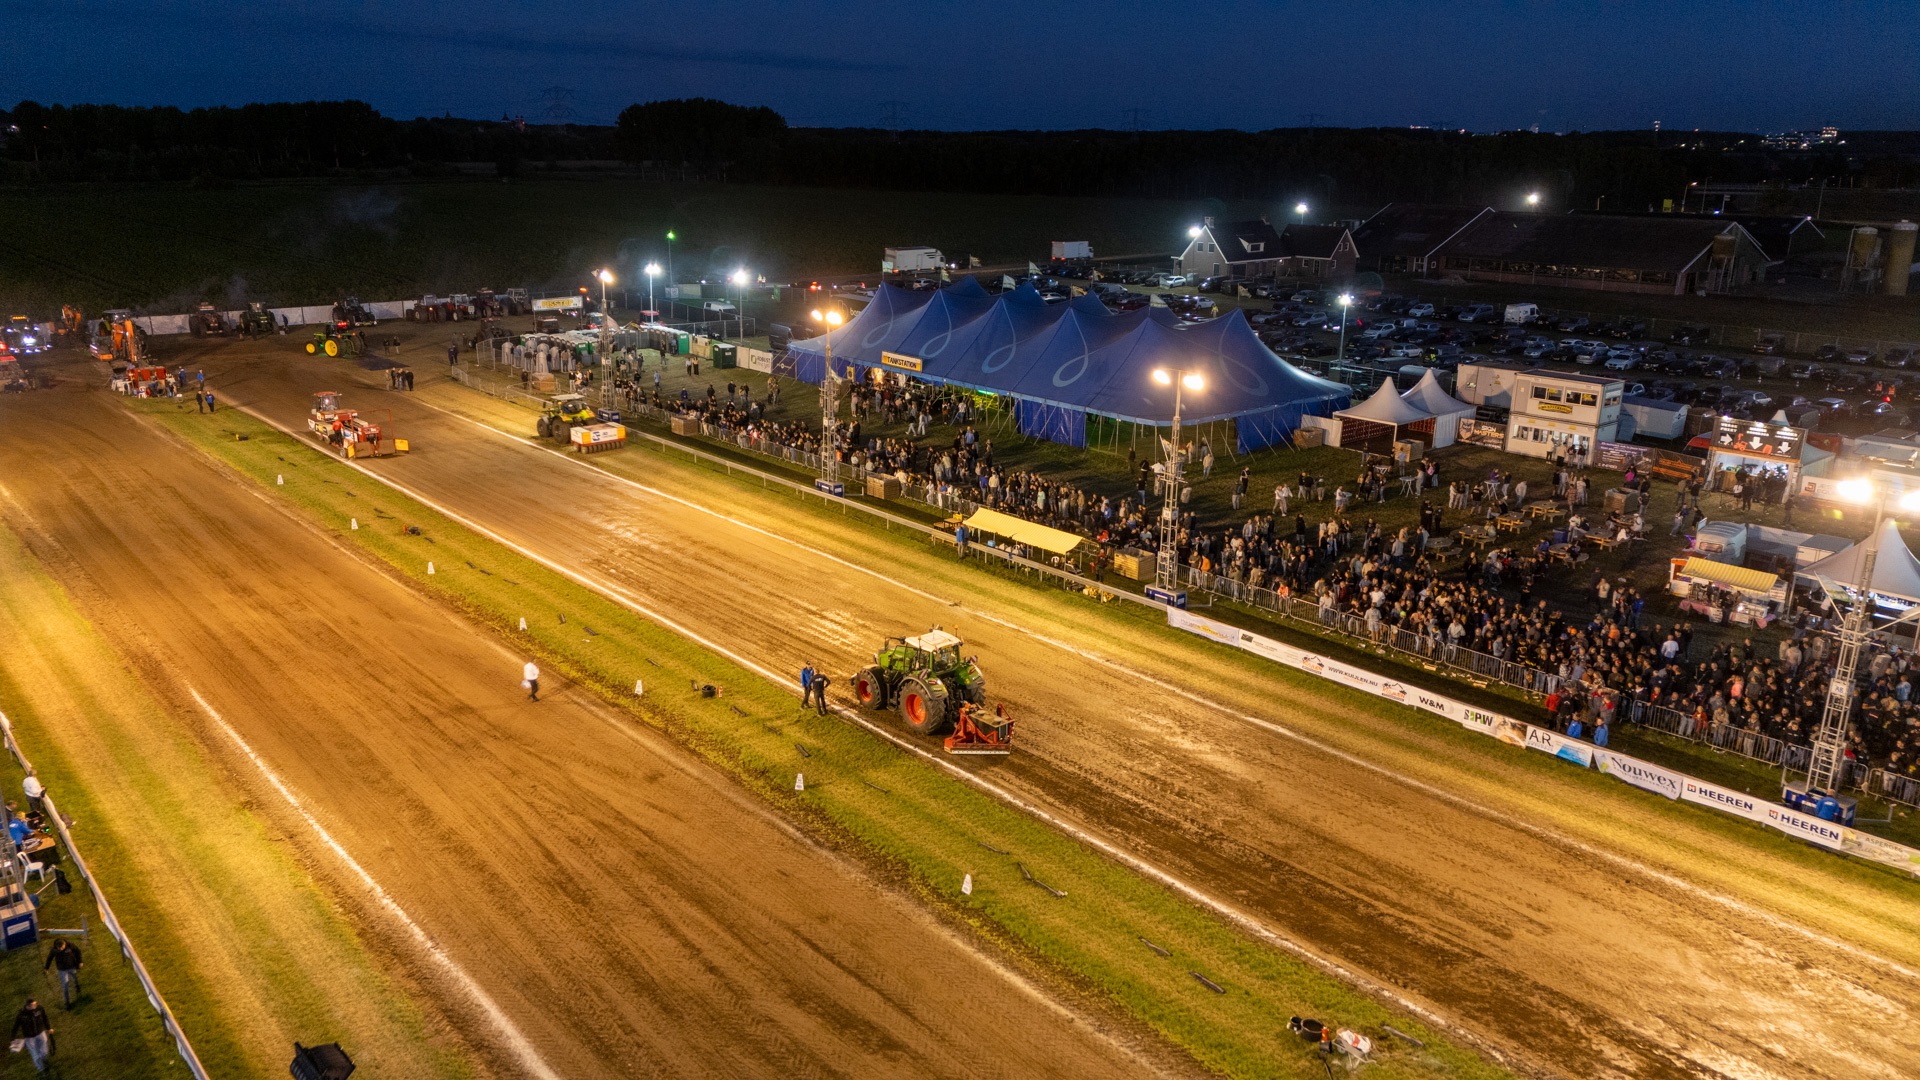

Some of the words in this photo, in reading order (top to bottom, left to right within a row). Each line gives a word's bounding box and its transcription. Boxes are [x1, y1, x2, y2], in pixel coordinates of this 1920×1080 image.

[887, 356, 917, 369] TANKSTATION
[1474, 430, 1505, 439] MASTERS
[1328, 666, 1379, 687] WWW.KUIJLEN.NU
[1419, 696, 1445, 711] W&M
[1611, 757, 1677, 790] Nouwex
[1699, 787, 1753, 811] HEEREN
[1781, 814, 1839, 841] HEEREN
